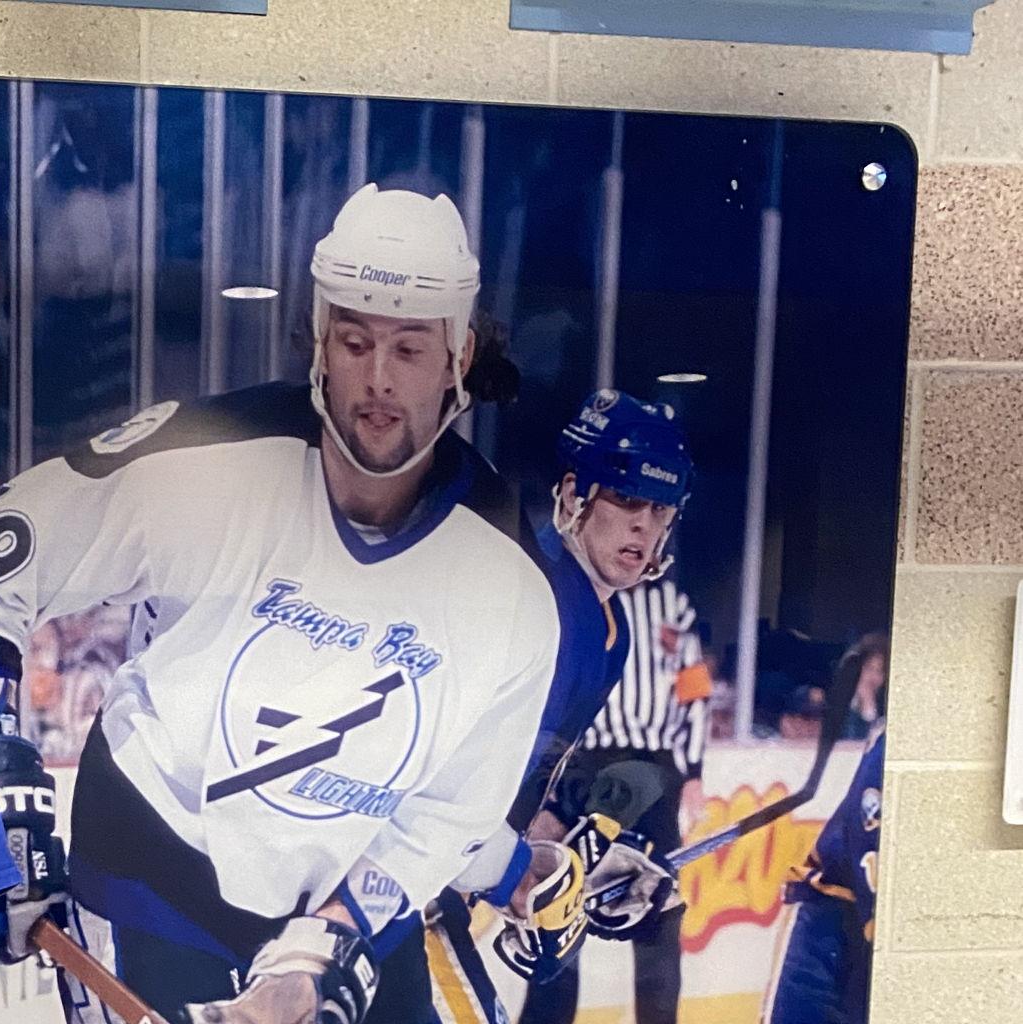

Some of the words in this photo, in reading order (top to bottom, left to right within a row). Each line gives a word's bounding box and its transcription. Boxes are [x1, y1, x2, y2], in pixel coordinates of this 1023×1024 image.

[359, 264, 411, 287] Cooper
[640, 462, 678, 485] Sabres
[252, 578, 369, 650] Tampa
[372, 621, 443, 680] Bay
